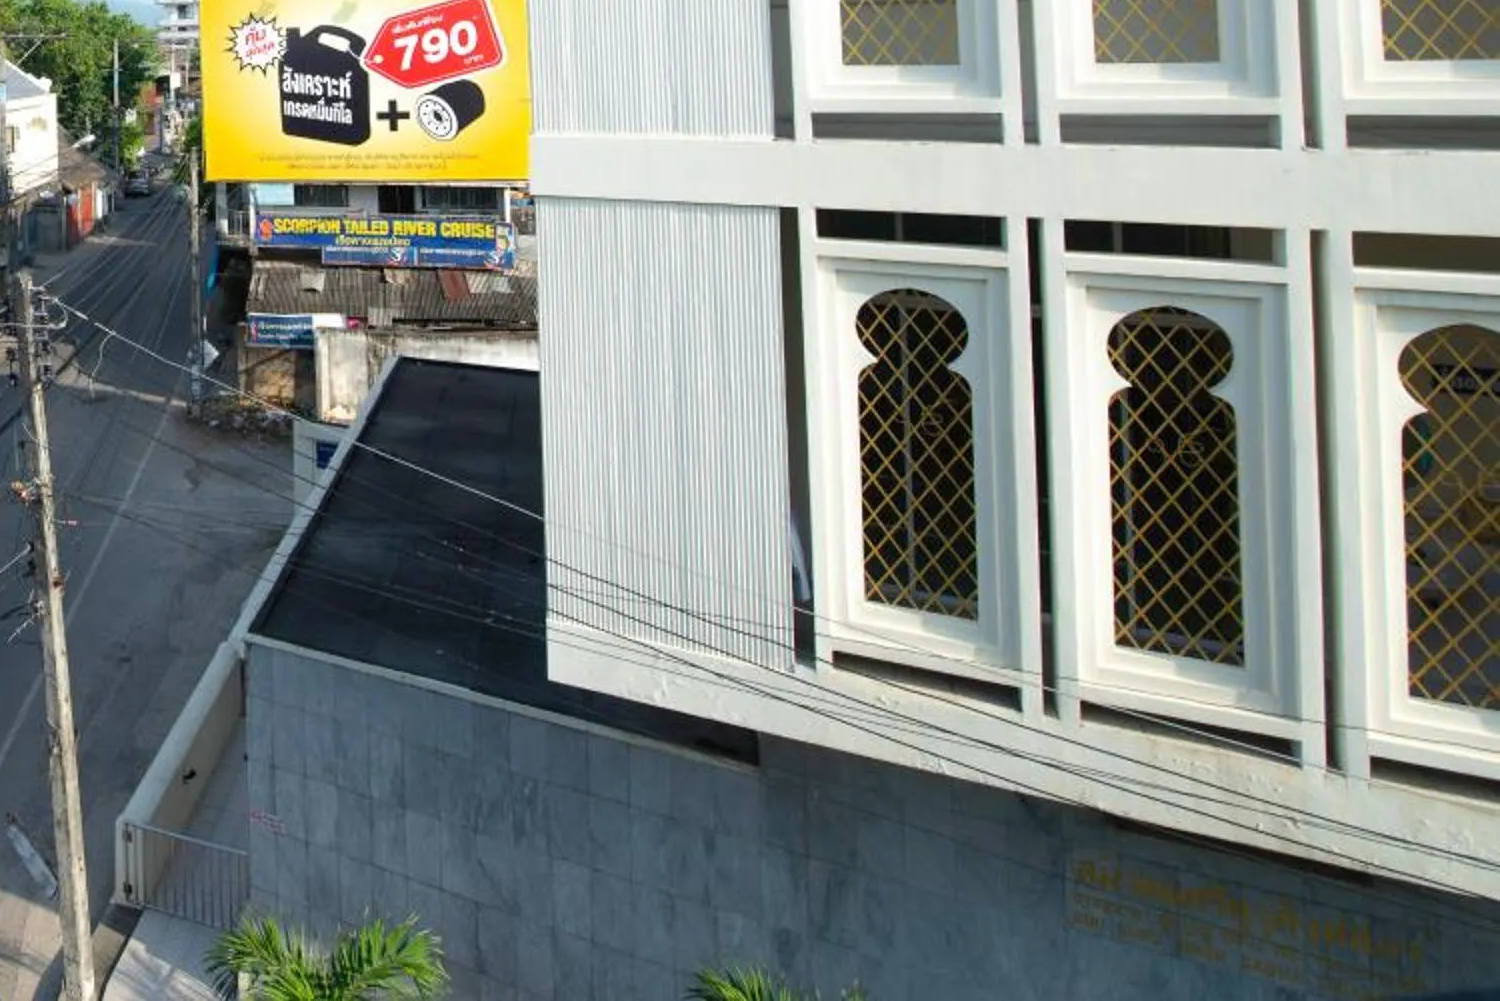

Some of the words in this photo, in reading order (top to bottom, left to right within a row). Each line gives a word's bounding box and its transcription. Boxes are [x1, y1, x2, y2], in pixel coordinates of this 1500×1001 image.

[393, 20, 478, 72] 790
[282, 65, 353, 99] สังเคราะห์
[274, 218, 340, 234] SCORPION
[344, 219, 389, 235] TAILED
[393, 220, 436, 236] RIVER
[440, 222, 494, 238] CRUISE
